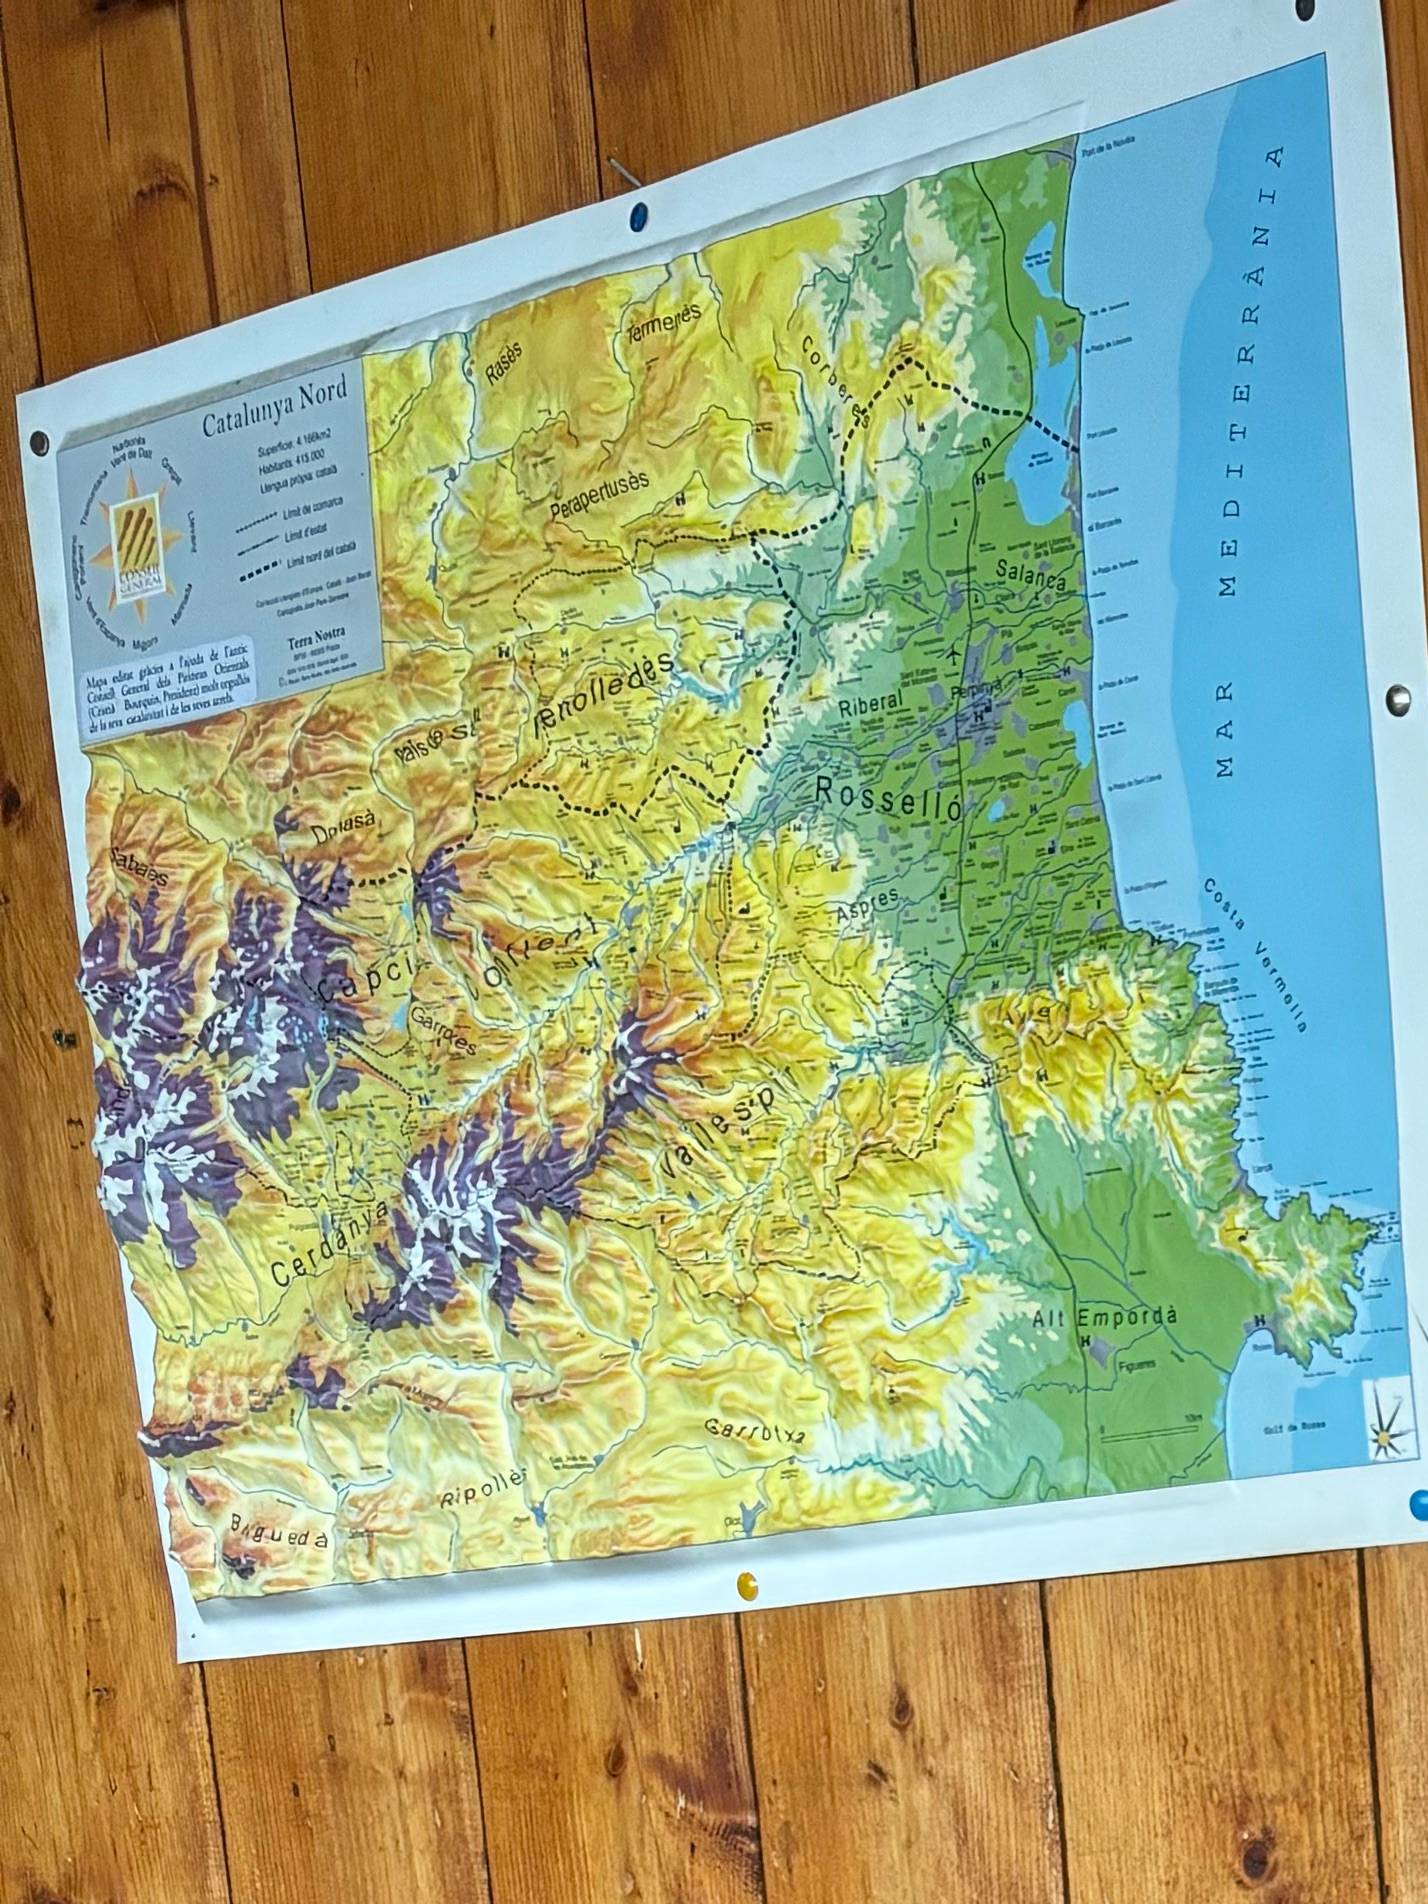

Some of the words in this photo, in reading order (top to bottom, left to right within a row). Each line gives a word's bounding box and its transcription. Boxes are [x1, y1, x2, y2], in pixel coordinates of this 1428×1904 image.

[1218, 146, 1284, 597] MEDITERRÀNIA
[203, 397, 294, 438] Catalunya
[299, 373, 348, 410] Nord
[314, 627, 346, 644] Nostra
[839, 689, 903, 719] Riberal
[1216, 682, 1233, 778] MAR
[815, 775, 962, 823] Rosselló
[836, 886, 898, 924] Aspres
[1204, 878, 1245, 931] Costa
[271, 1200, 388, 1287] Cerdanya
[1032, 1309, 1064, 1328] Alt
[1078, 1304, 1178, 1328] Empordà
